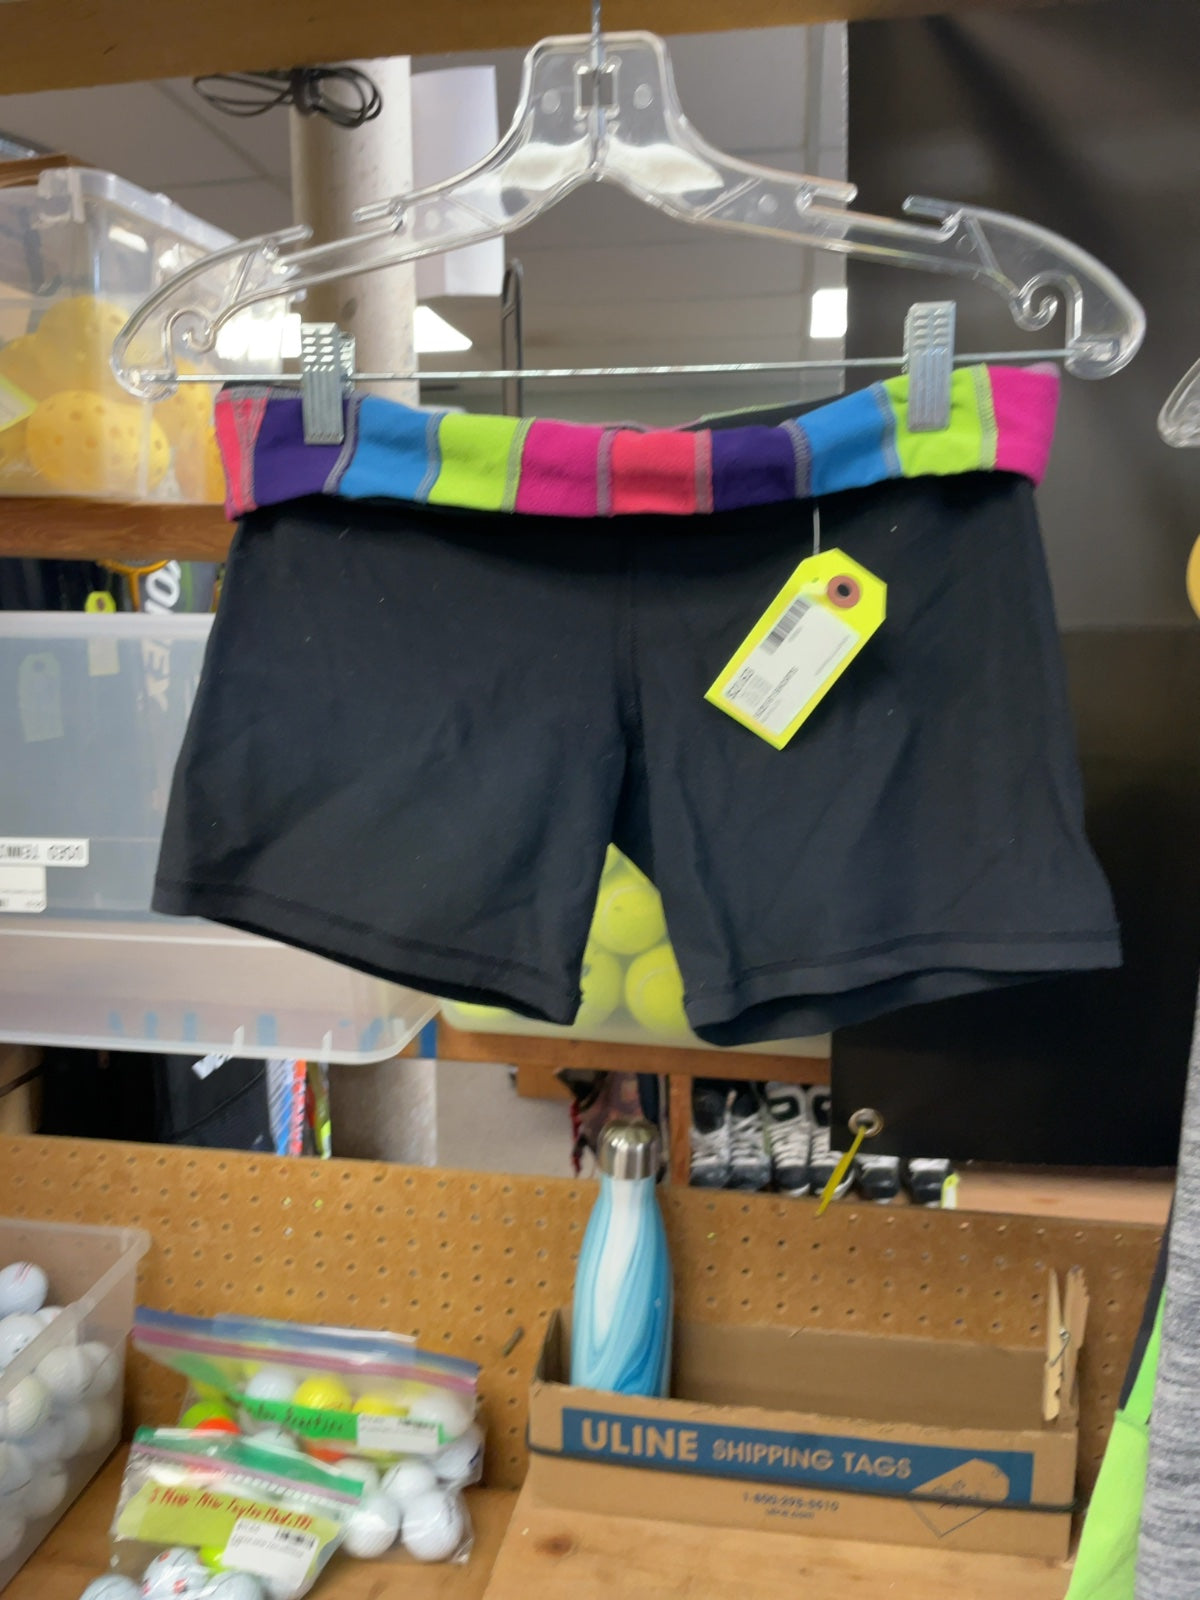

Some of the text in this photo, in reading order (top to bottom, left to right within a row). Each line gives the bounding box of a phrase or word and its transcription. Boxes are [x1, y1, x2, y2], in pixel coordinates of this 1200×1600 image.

[581, 1418, 912, 1479] ULINE SHIPPING TAGS
